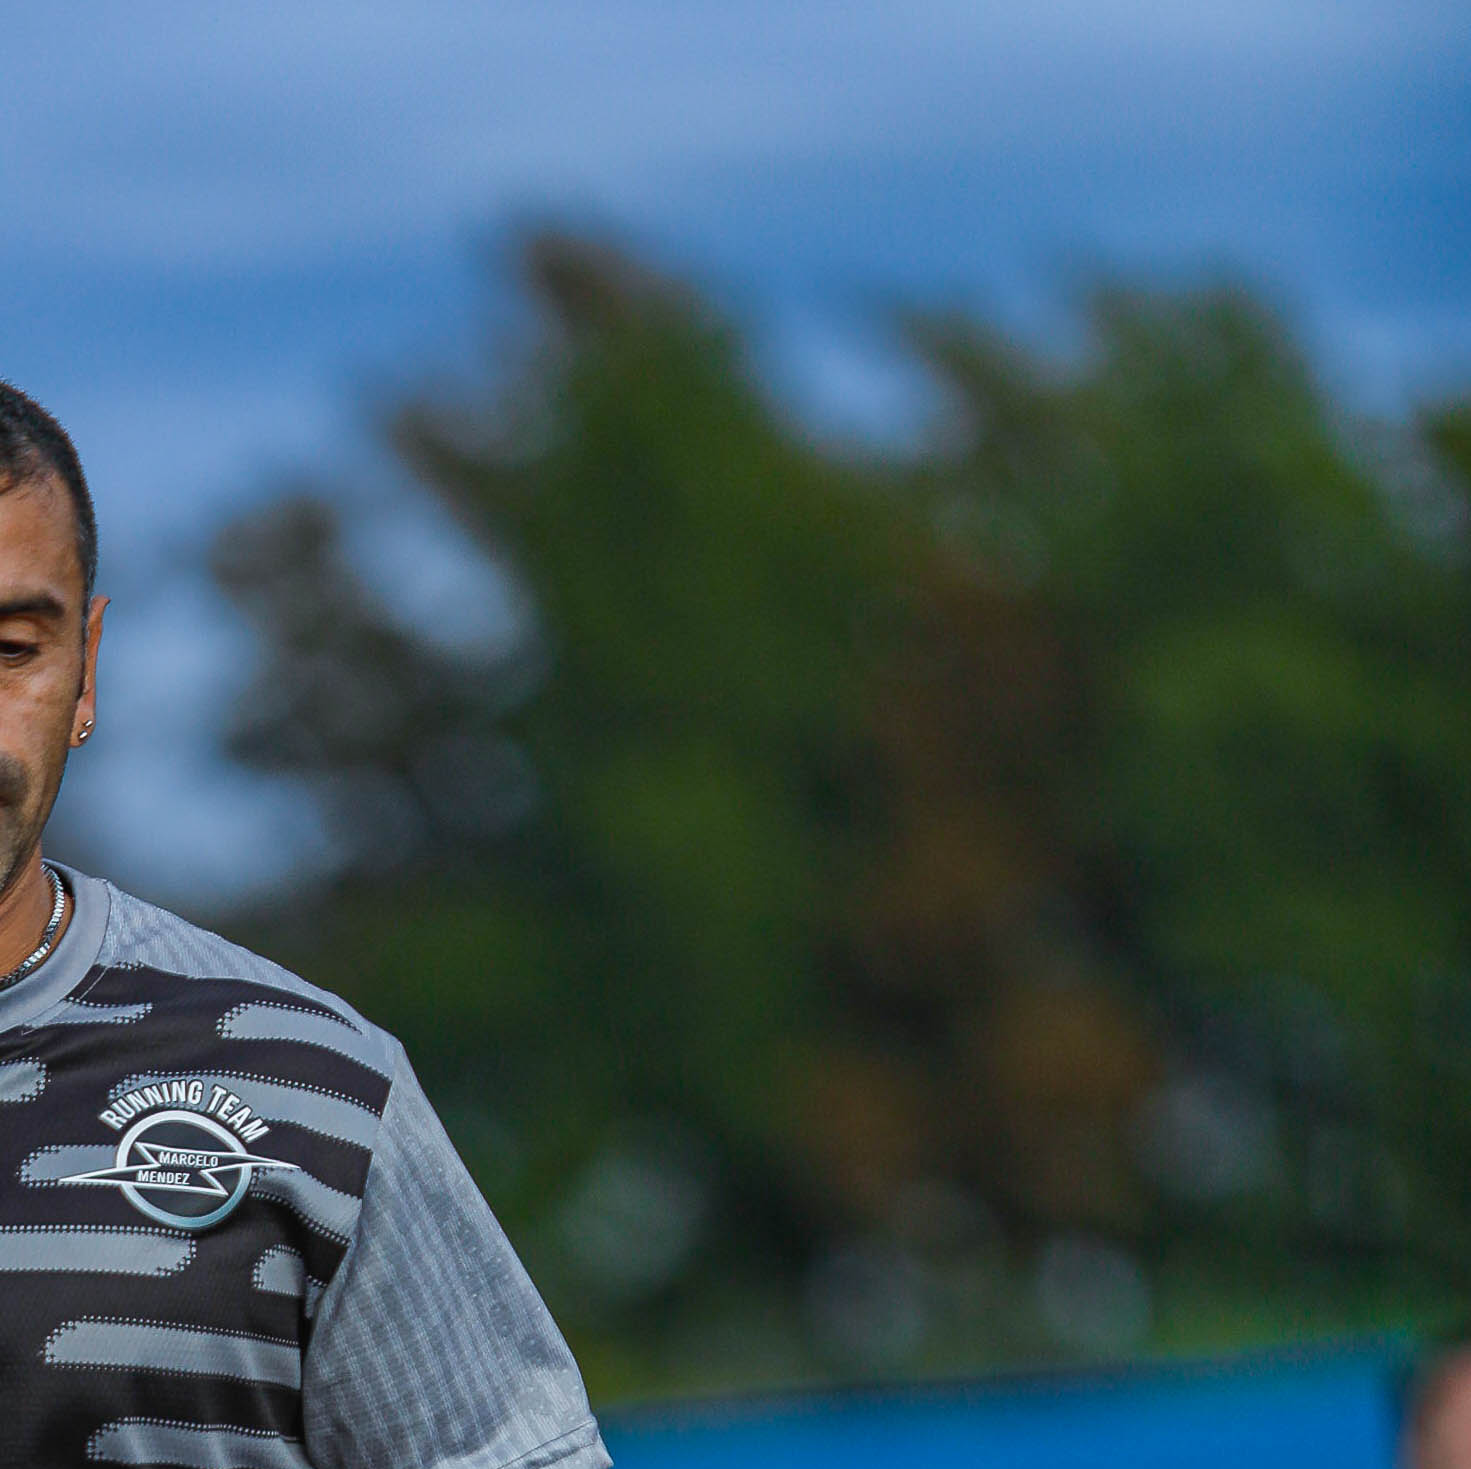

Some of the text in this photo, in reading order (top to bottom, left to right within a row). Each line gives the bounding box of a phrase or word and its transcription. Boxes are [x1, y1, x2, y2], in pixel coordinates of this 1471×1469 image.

[99, 1080, 271, 1144] RUNNING TEAM
[158, 1151, 219, 1168] MARCELO
[137, 1169, 191, 1186] MENDEZ
